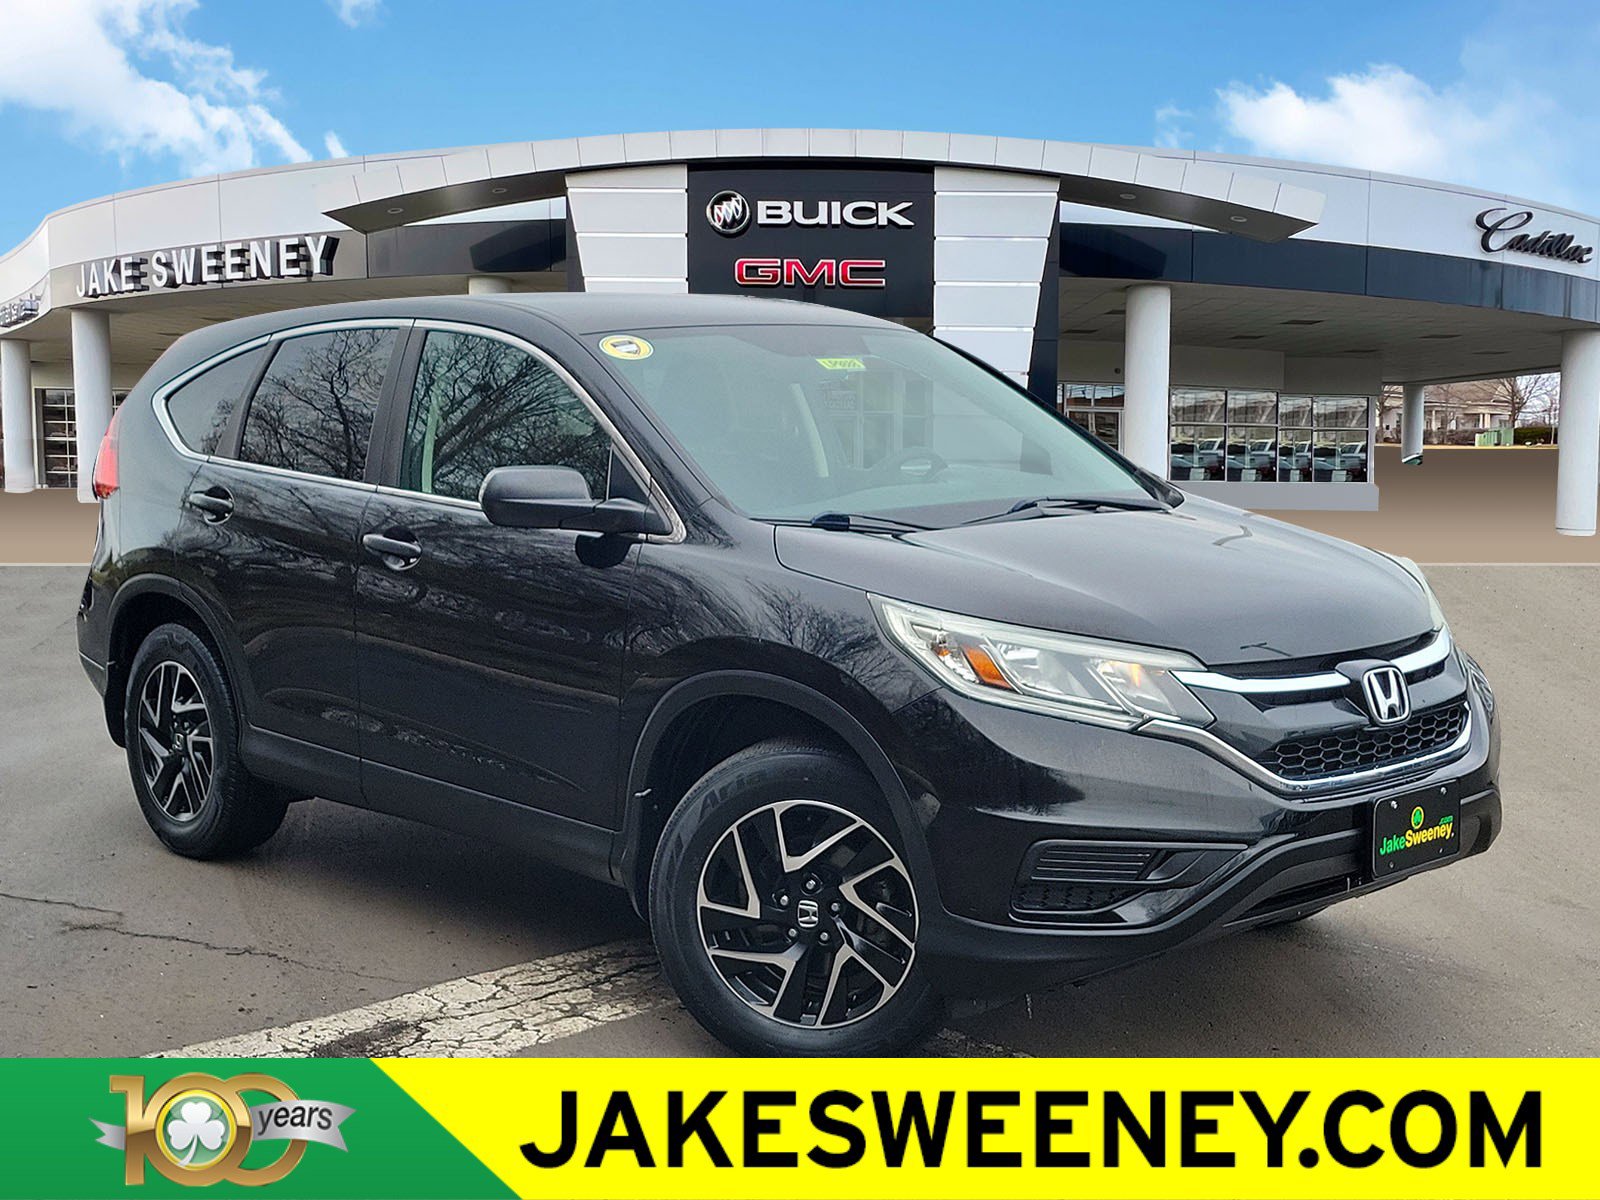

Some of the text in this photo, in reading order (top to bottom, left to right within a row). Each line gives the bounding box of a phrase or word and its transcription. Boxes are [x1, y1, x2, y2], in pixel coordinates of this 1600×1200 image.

[757, 200, 915, 227] BUICK
[1475, 207, 1594, 264] Cadillac
[76, 234, 331, 299] JAKE SWEENEY
[734, 257, 887, 287] GMC
